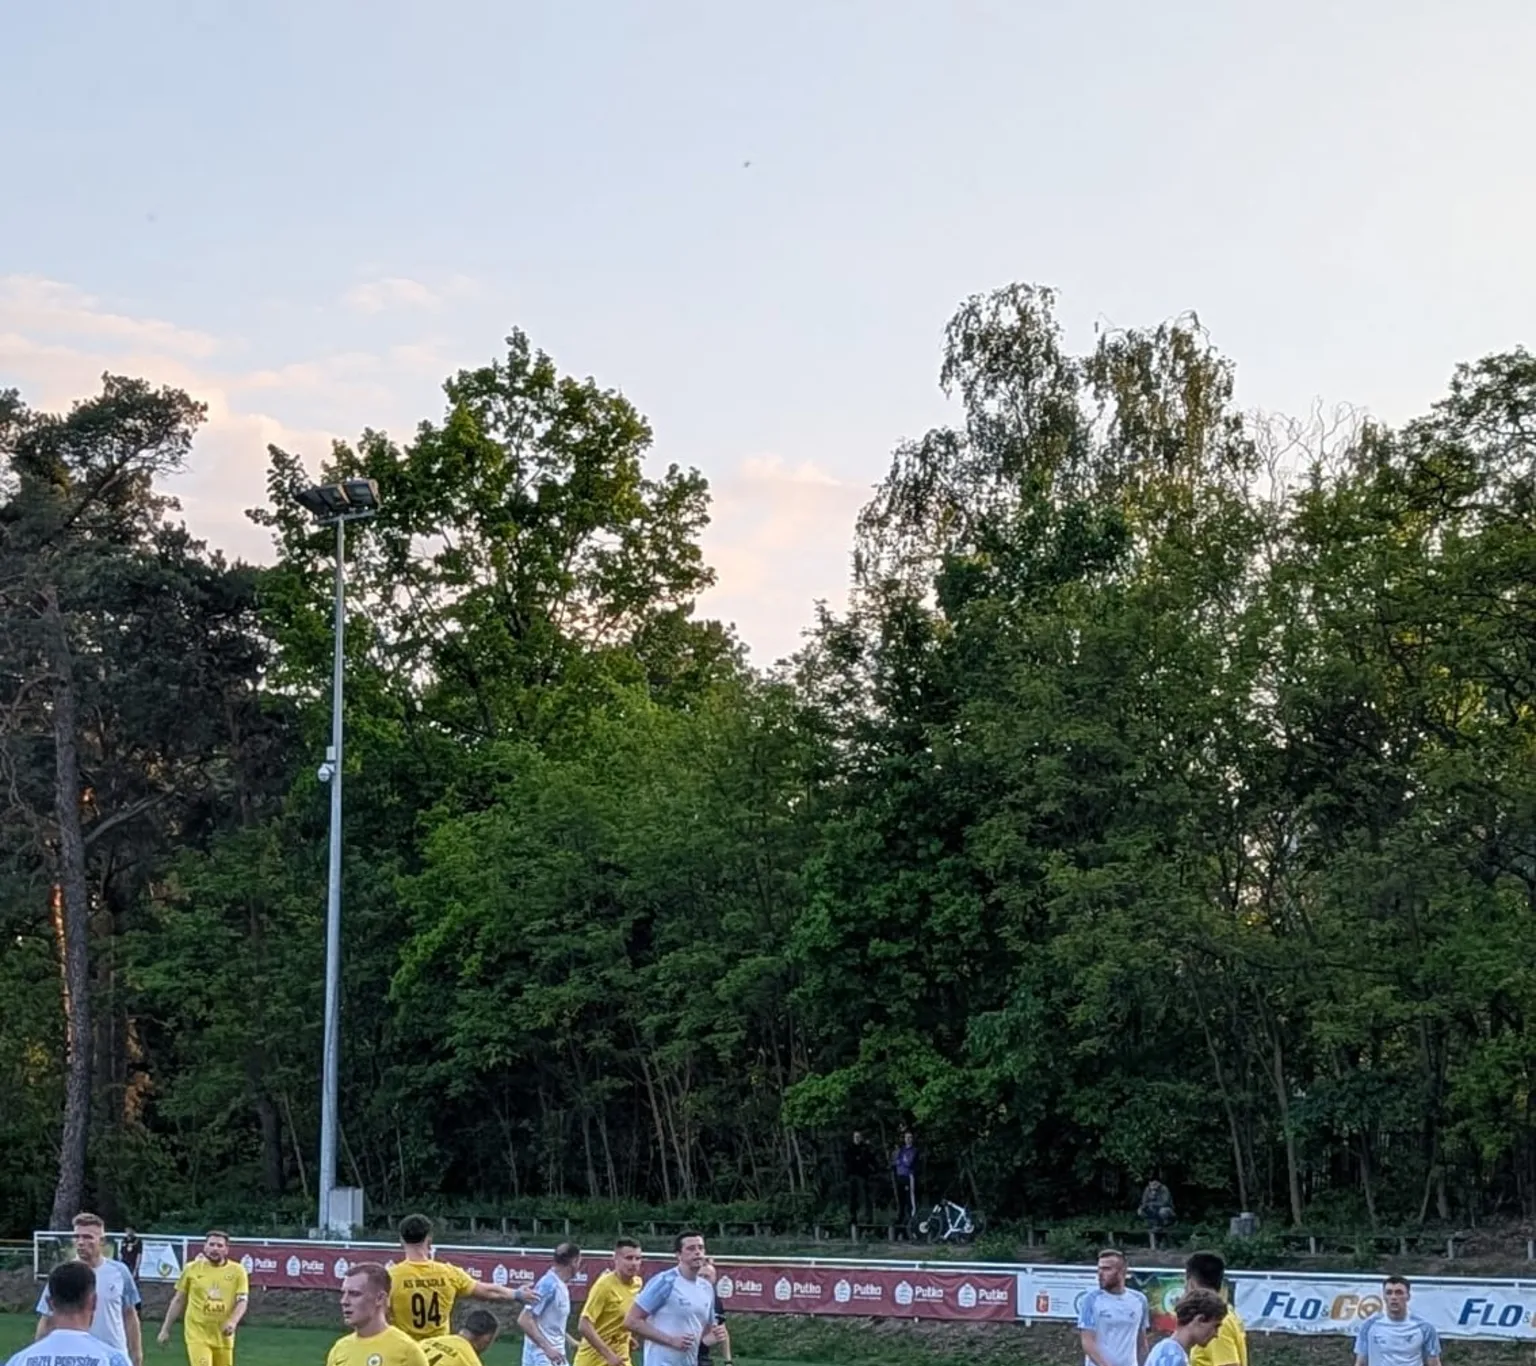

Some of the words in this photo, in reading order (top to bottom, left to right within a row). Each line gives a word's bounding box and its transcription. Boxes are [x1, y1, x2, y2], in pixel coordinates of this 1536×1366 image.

[793, 1282, 821, 1294] Putka
[853, 1284, 882, 1296] Putka
[915, 1286, 944, 1298] Putka
[979, 1289, 1008, 1301] Putka
[411, 1292, 441, 1329] 94
